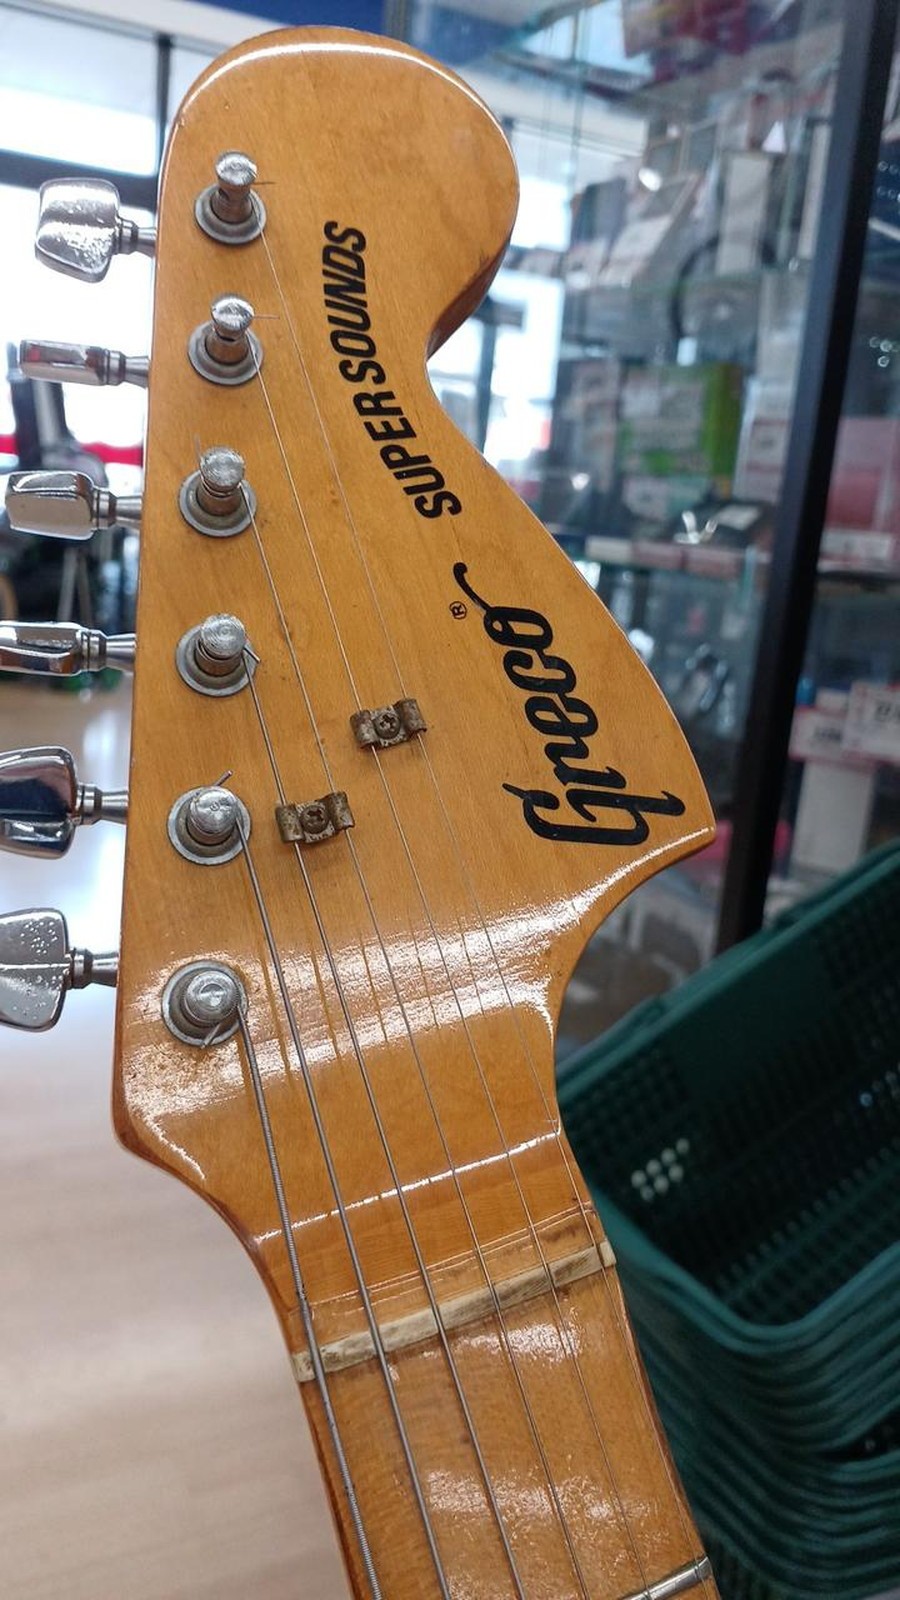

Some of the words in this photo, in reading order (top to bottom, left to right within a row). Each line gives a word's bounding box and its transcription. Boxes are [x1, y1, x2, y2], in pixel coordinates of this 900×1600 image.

[322, 221, 386, 385] SOUNDS
[353, 391, 462, 518] SUPER
[453, 562, 686, 846] Greco
